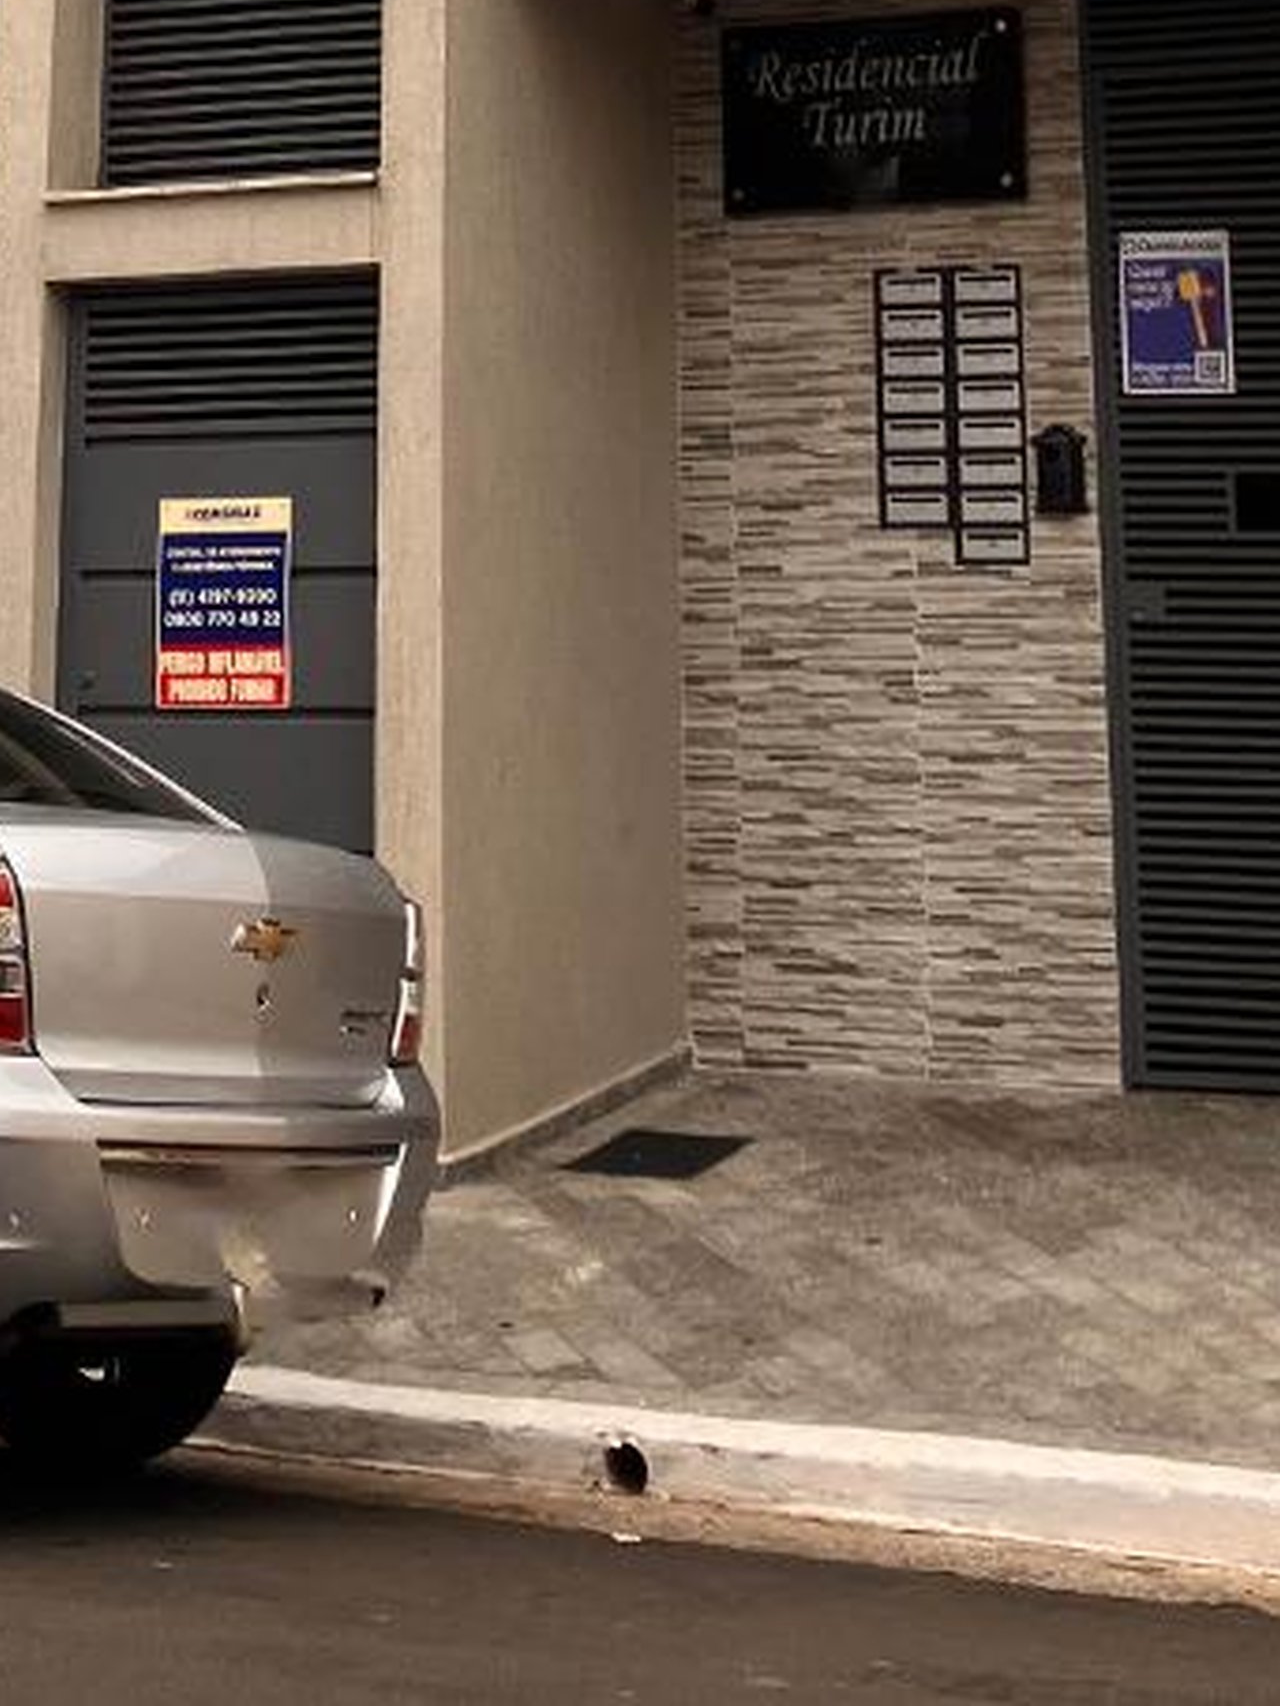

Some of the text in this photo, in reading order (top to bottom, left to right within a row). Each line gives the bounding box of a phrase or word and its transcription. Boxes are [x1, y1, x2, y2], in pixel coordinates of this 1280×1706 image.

[750, 33, 984, 101] Residencial
[803, 97, 925, 146] Turim
[262, 609, 282, 627] 22
